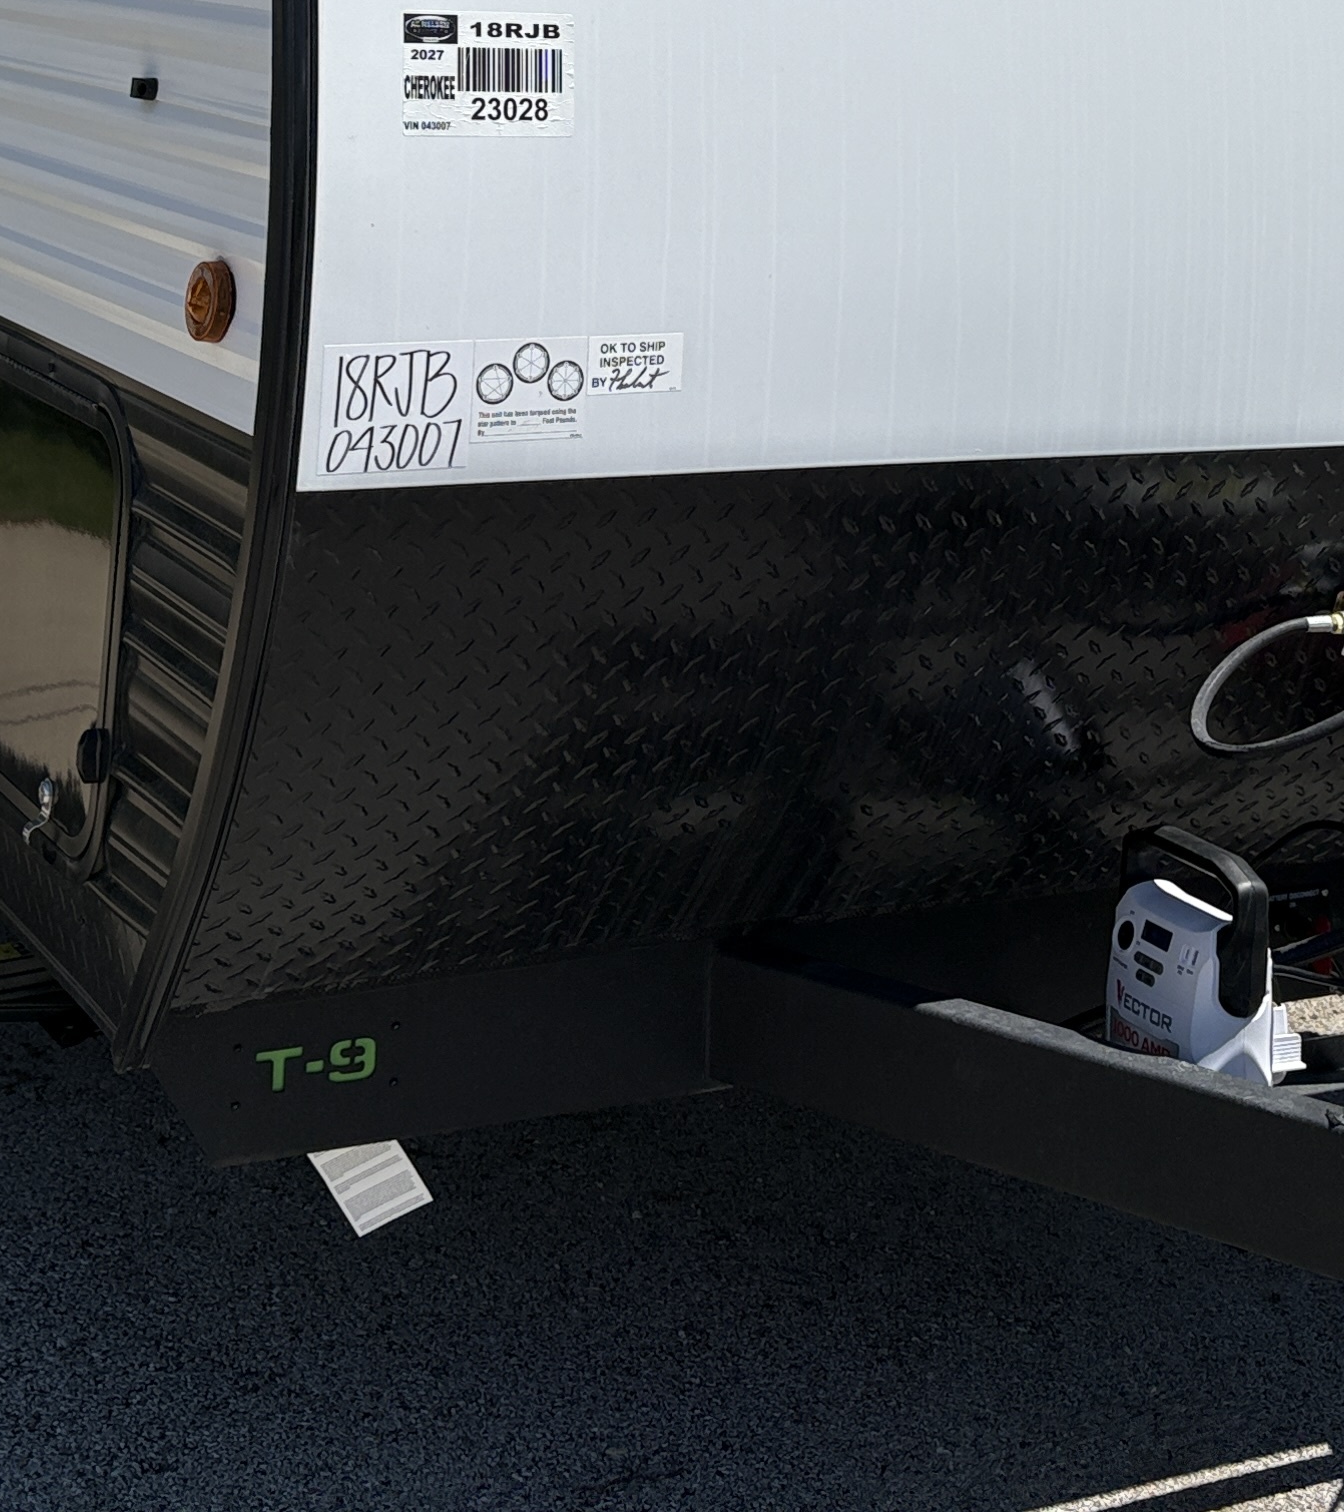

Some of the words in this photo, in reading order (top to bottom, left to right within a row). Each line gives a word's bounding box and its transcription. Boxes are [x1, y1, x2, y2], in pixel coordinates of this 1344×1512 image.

[470, 22, 561, 39] 18RJB
[410, 49, 445, 61] 2027
[404, 75, 456, 100] CHEROKEE
[471, 97, 549, 121] 23028
[404, 122, 419, 131] VIN
[421, 122, 451, 131] 043007
[600, 343, 618, 354] OK
[620, 342, 636, 353] TO
[639, 341, 666, 352] SHIP
[599, 354, 665, 368] INSPECTED
[333, 349, 458, 428] 18RJB
[591, 377, 607, 388] BY
[325, 418, 462, 474] 043007
[1116, 978, 1173, 1034] VECTOR
[1113, 1018, 1140, 1048] 1000
[255, 1037, 377, 1092] T-9
